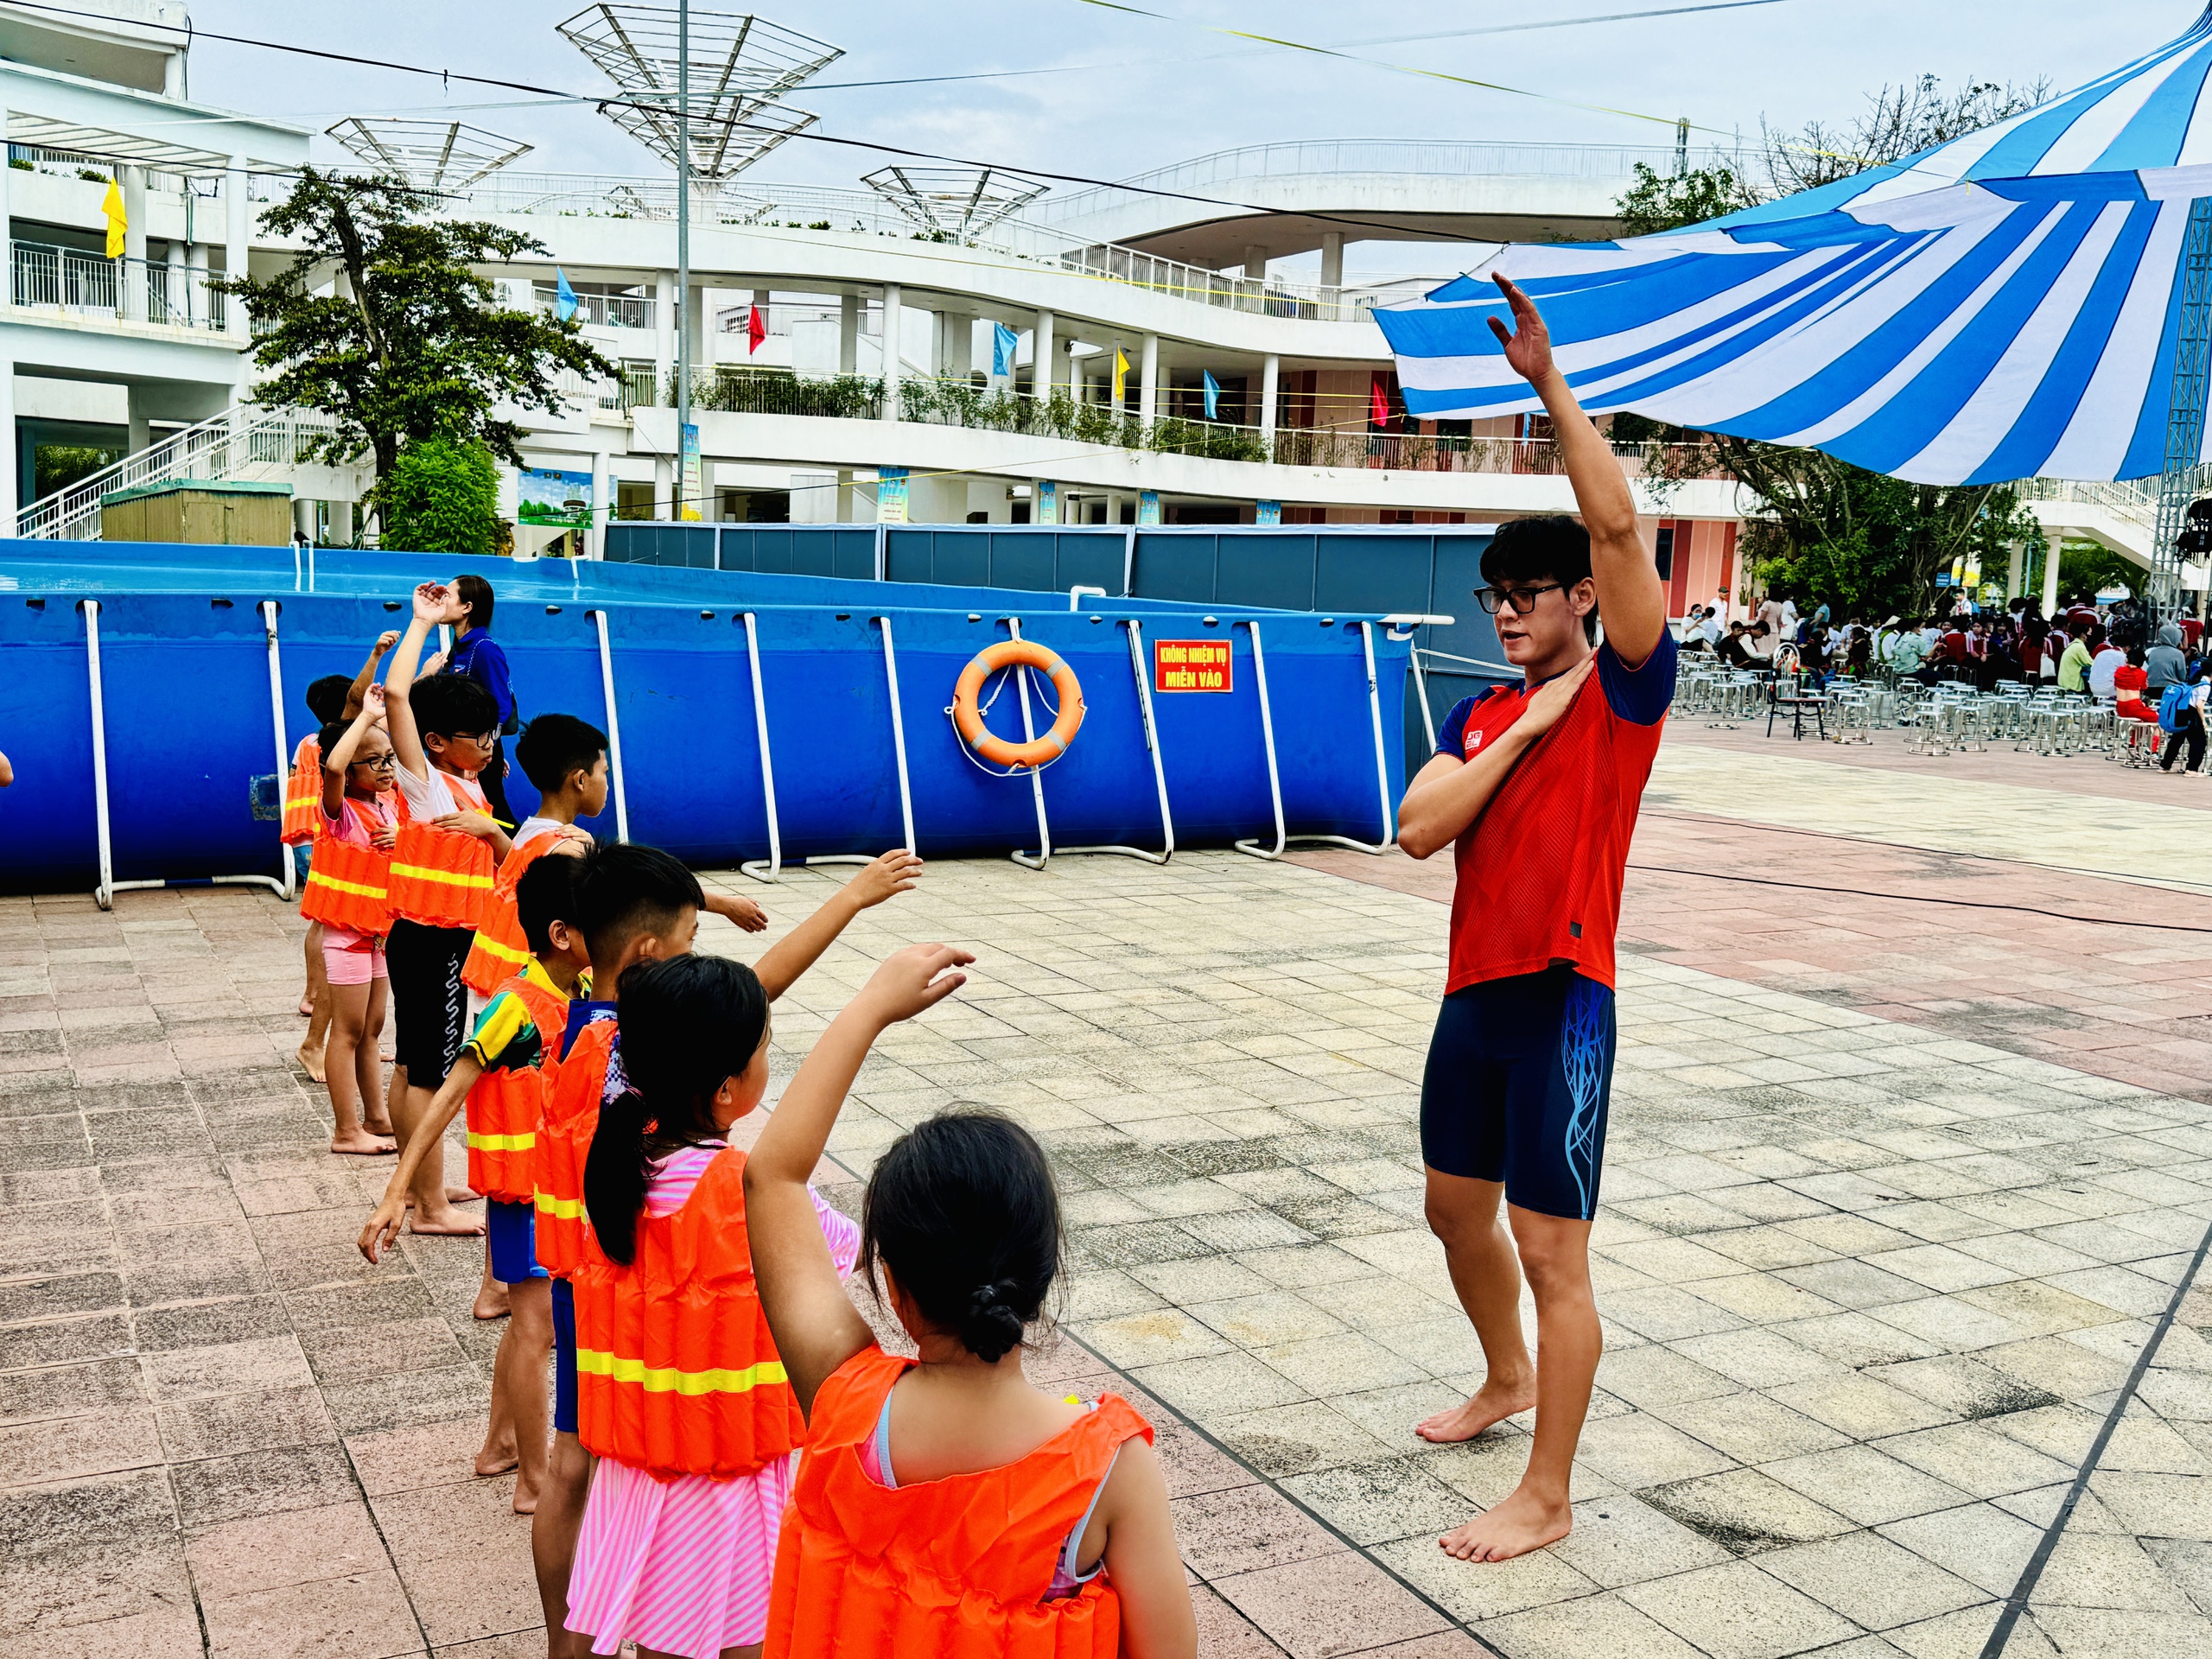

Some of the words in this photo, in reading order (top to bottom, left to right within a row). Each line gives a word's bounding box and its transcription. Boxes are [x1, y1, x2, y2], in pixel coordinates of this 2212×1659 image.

[1160, 644, 1187, 663] KHÔNG
[1188, 645, 1214, 666] NHIỆM
[1216, 647, 1226, 666] VỤ
[1166, 666, 1196, 687] MIỄN
[1198, 669, 1223, 688] VÀO
